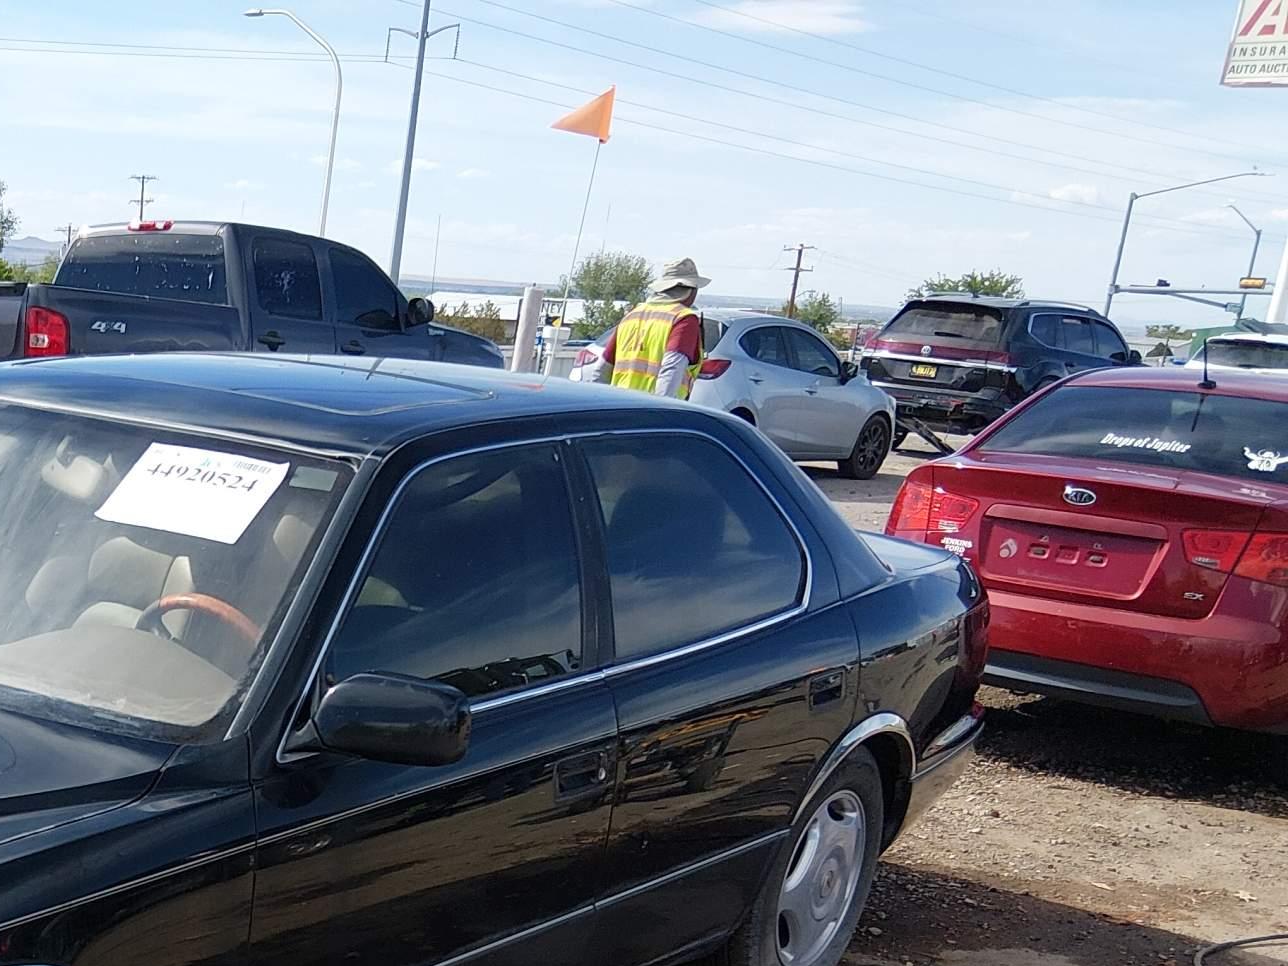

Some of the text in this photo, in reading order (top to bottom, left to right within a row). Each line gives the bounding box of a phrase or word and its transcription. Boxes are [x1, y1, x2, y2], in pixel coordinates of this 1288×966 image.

[1227, 63, 1257, 74] AUTO
[1100, 433, 1192, 453] Drops of Jupiter
[146, 463, 258, 492] 44920524
[944, 545, 966, 553] FORD
[1183, 592, 1205, 601] EX
